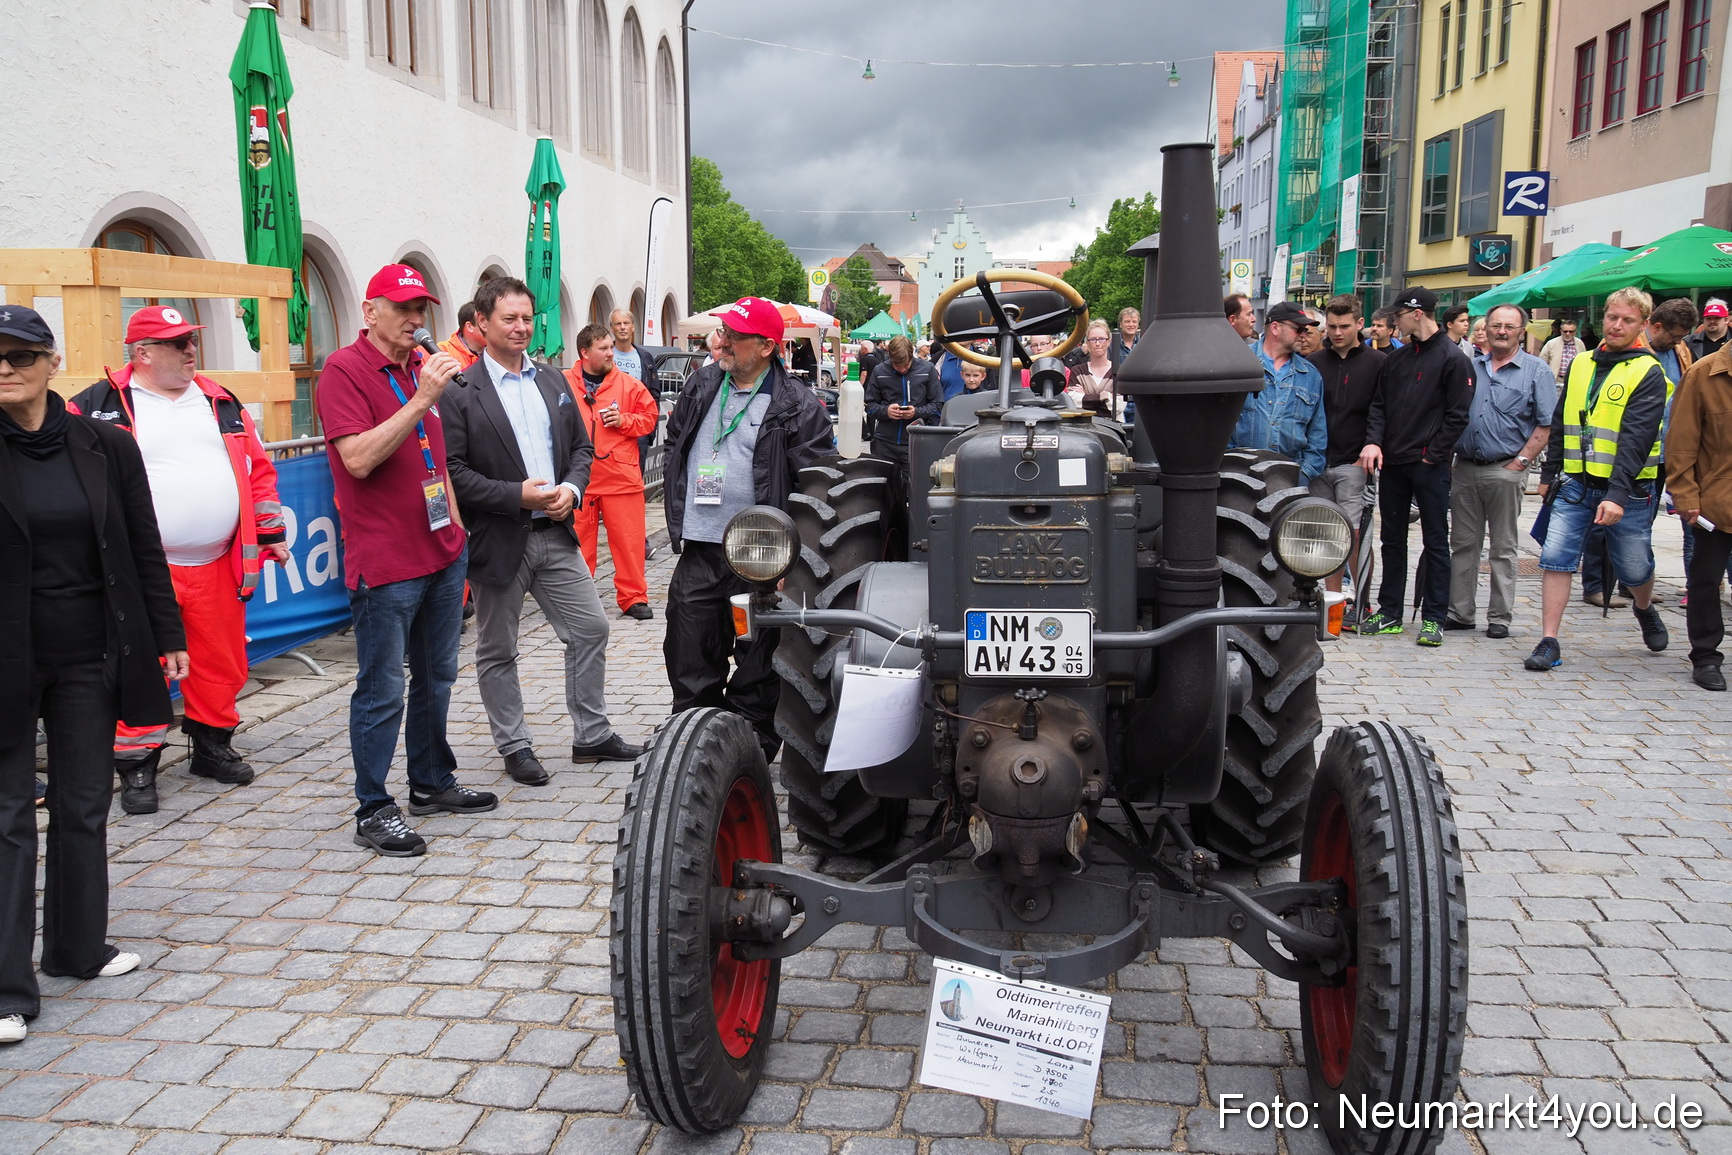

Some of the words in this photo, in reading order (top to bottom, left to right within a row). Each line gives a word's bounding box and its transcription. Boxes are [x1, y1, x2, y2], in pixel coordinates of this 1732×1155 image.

[398, 277, 424, 288] DEKRA
[998, 532, 1063, 555] LANZ
[976, 556, 1085, 578] BULLDOG
[973, 629, 981, 639] D
[990, 615, 1029, 642] NM
[974, 646, 1012, 672] AW
[1019, 646, 1056, 672] 43
[1066, 646, 1083, 656] 04
[1066, 663, 1083, 673] 09
[996, 987, 1102, 1020] Oldtimertreffen
[1006, 1007, 1099, 1039] Mariahilfberg
[975, 1016, 1042, 1043] Neumarkt
[1045, 1034, 1095, 1055] i.d.OPf.
[959, 1045, 998, 1062] Wolfgang
[1033, 1064, 1042, 1073] D
[1045, 1067, 1068, 1080] 7506
[1047, 1058, 1074, 1070] Lanz
[1034, 1095, 1061, 1108] 1940
